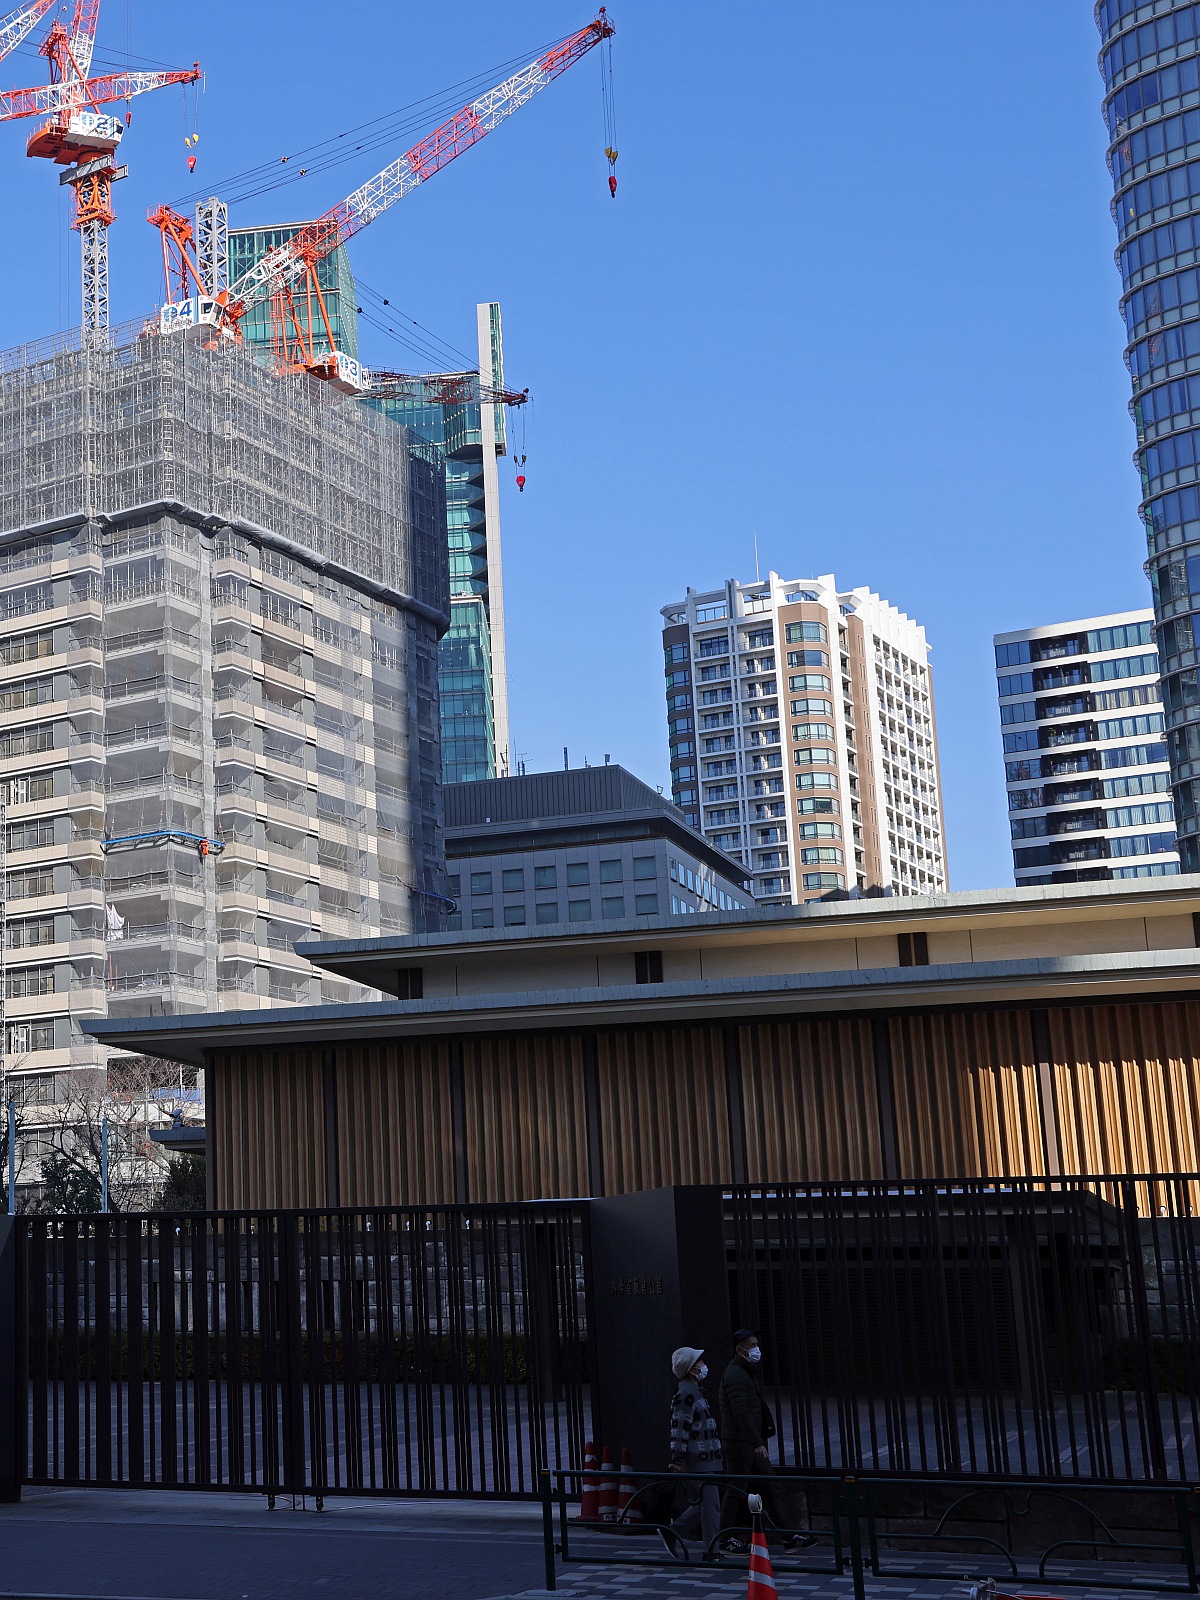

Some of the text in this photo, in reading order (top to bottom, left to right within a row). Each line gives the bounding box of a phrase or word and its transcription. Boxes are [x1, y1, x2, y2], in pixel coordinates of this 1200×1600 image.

[96, 117, 108, 130] 2
[179, 302, 192, 316] 4
[349, 361, 358, 376] 3
